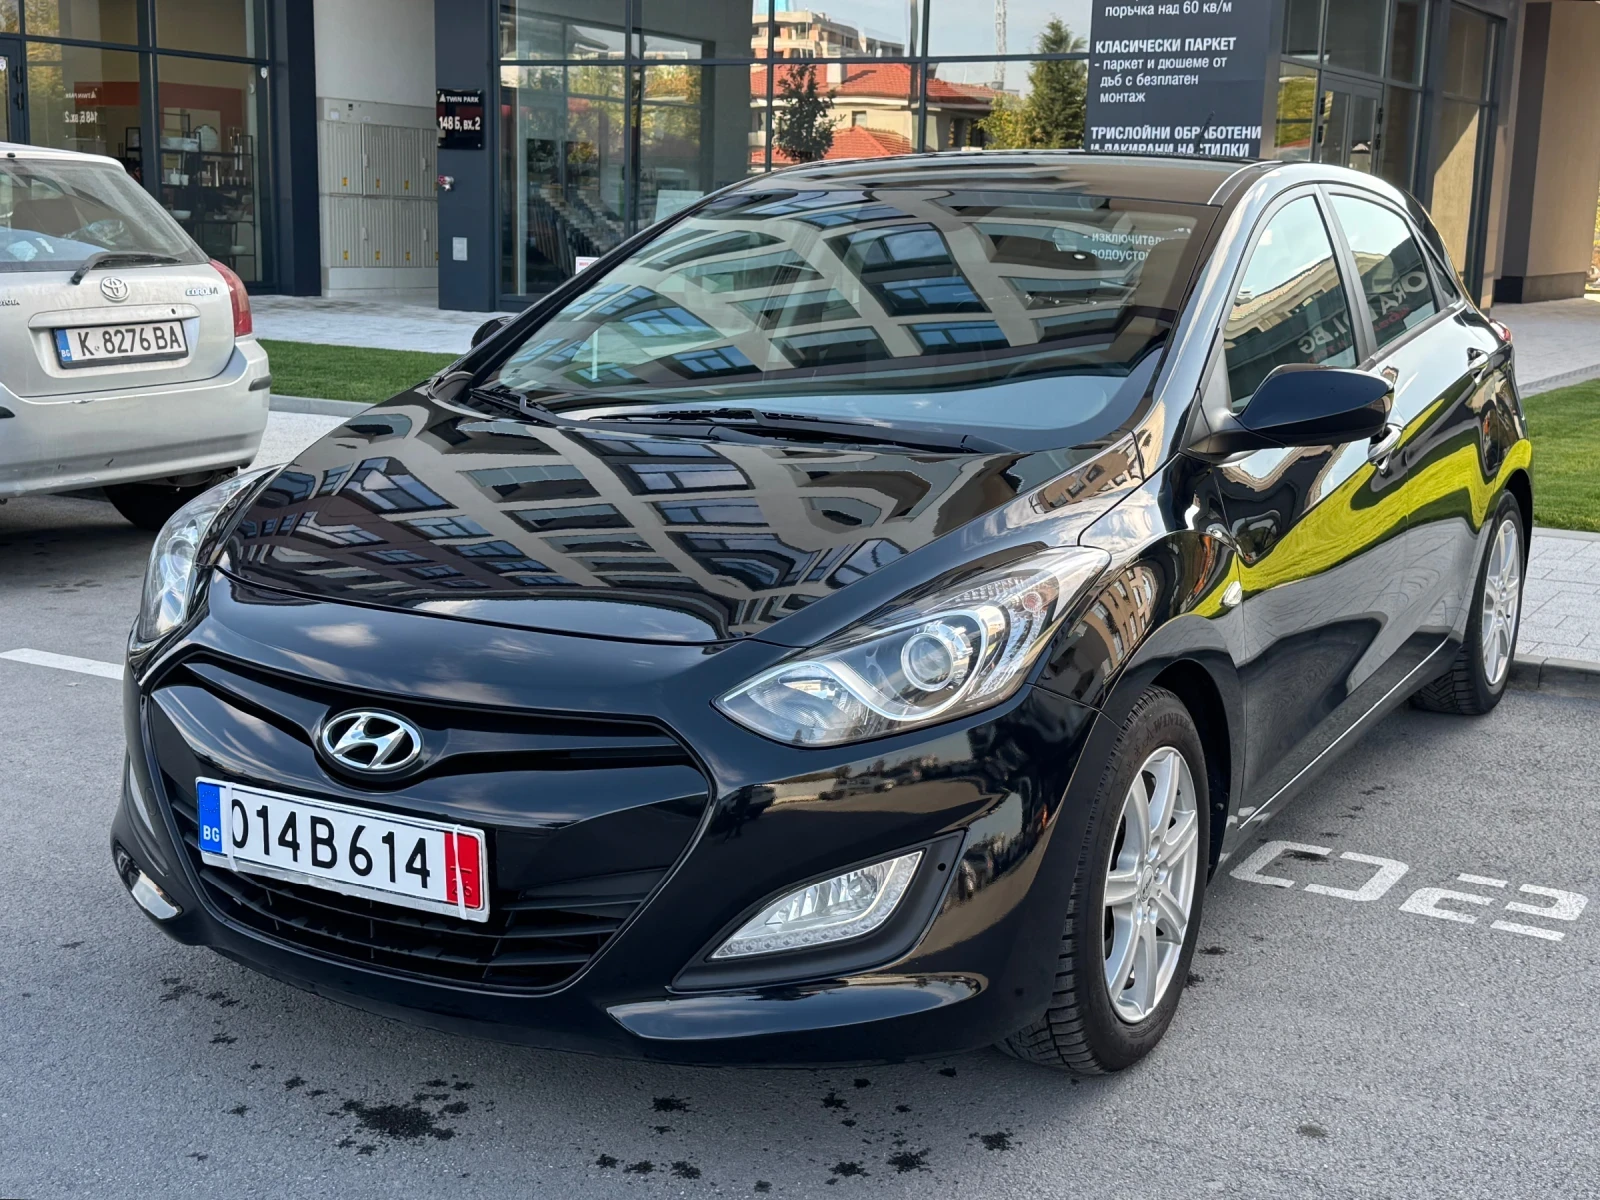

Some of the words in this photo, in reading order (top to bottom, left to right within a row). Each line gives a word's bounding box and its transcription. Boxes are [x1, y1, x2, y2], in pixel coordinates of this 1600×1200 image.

[1105, 2, 1154, 19] поръчка
[1158, 3, 1180, 16] над
[1183, 1, 1199, 14] 60
[1203, 1, 1232, 14] кв/м
[1095, 38, 1181, 53] КЛАСИЧЕСКИ
[1185, 37, 1236, 51] ПАРКЕТ
[1103, 58, 1143, 72] паркет
[1147, 59, 1154, 69] и
[1158, 57, 1209, 70] дюшеме
[1213, 56, 1227, 67] от
[1100, 73, 1122, 88] дъб
[1126, 76, 1132, 86] с
[1136, 73, 1199, 86] безплатен
[1100, 91, 1146, 103] монтаж
[439, 116, 453, 130] 148
[1091, 125, 1170, 140] ТРИСЛОЙНИ
[61, 349, 71, 358] BG
[78, 332, 94, 356] K
[103, 327, 151, 356] 8276
[154, 325, 182, 350] BA
[203, 825, 220, 843] BG
